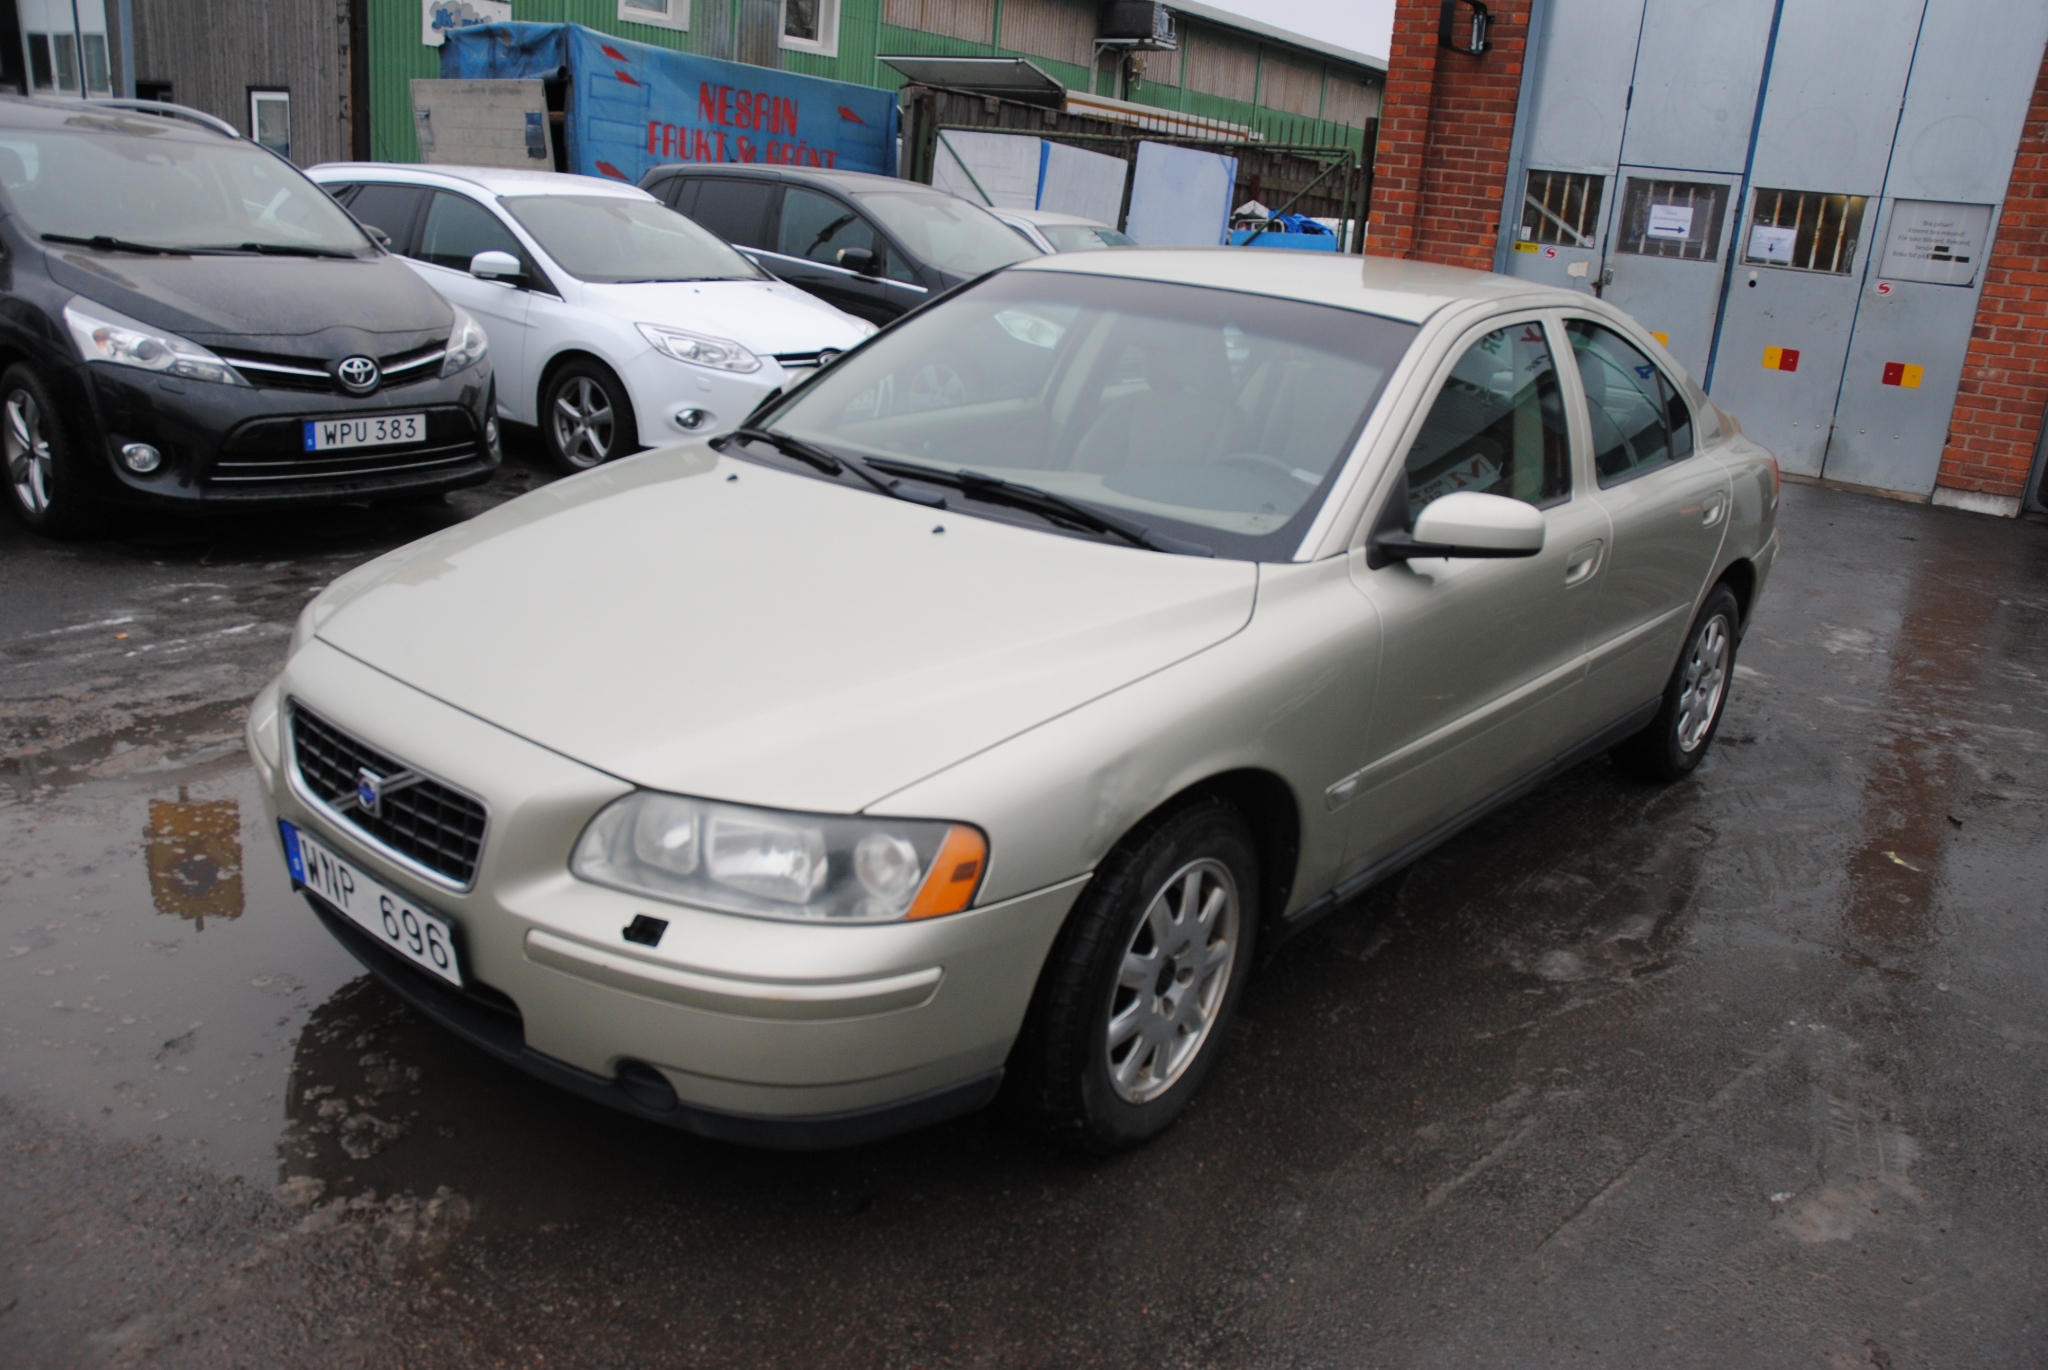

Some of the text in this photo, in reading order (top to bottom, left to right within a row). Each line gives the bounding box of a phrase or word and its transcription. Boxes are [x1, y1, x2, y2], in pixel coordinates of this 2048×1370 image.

[698, 81, 799, 137] NESRIN
[647, 121, 729, 164] FRUKT
[735, 135, 758, 164] &
[323, 421, 367, 446] WPU
[375, 417, 416, 441] 383
[301, 839, 355, 909] WNP
[380, 894, 448, 970] 696
